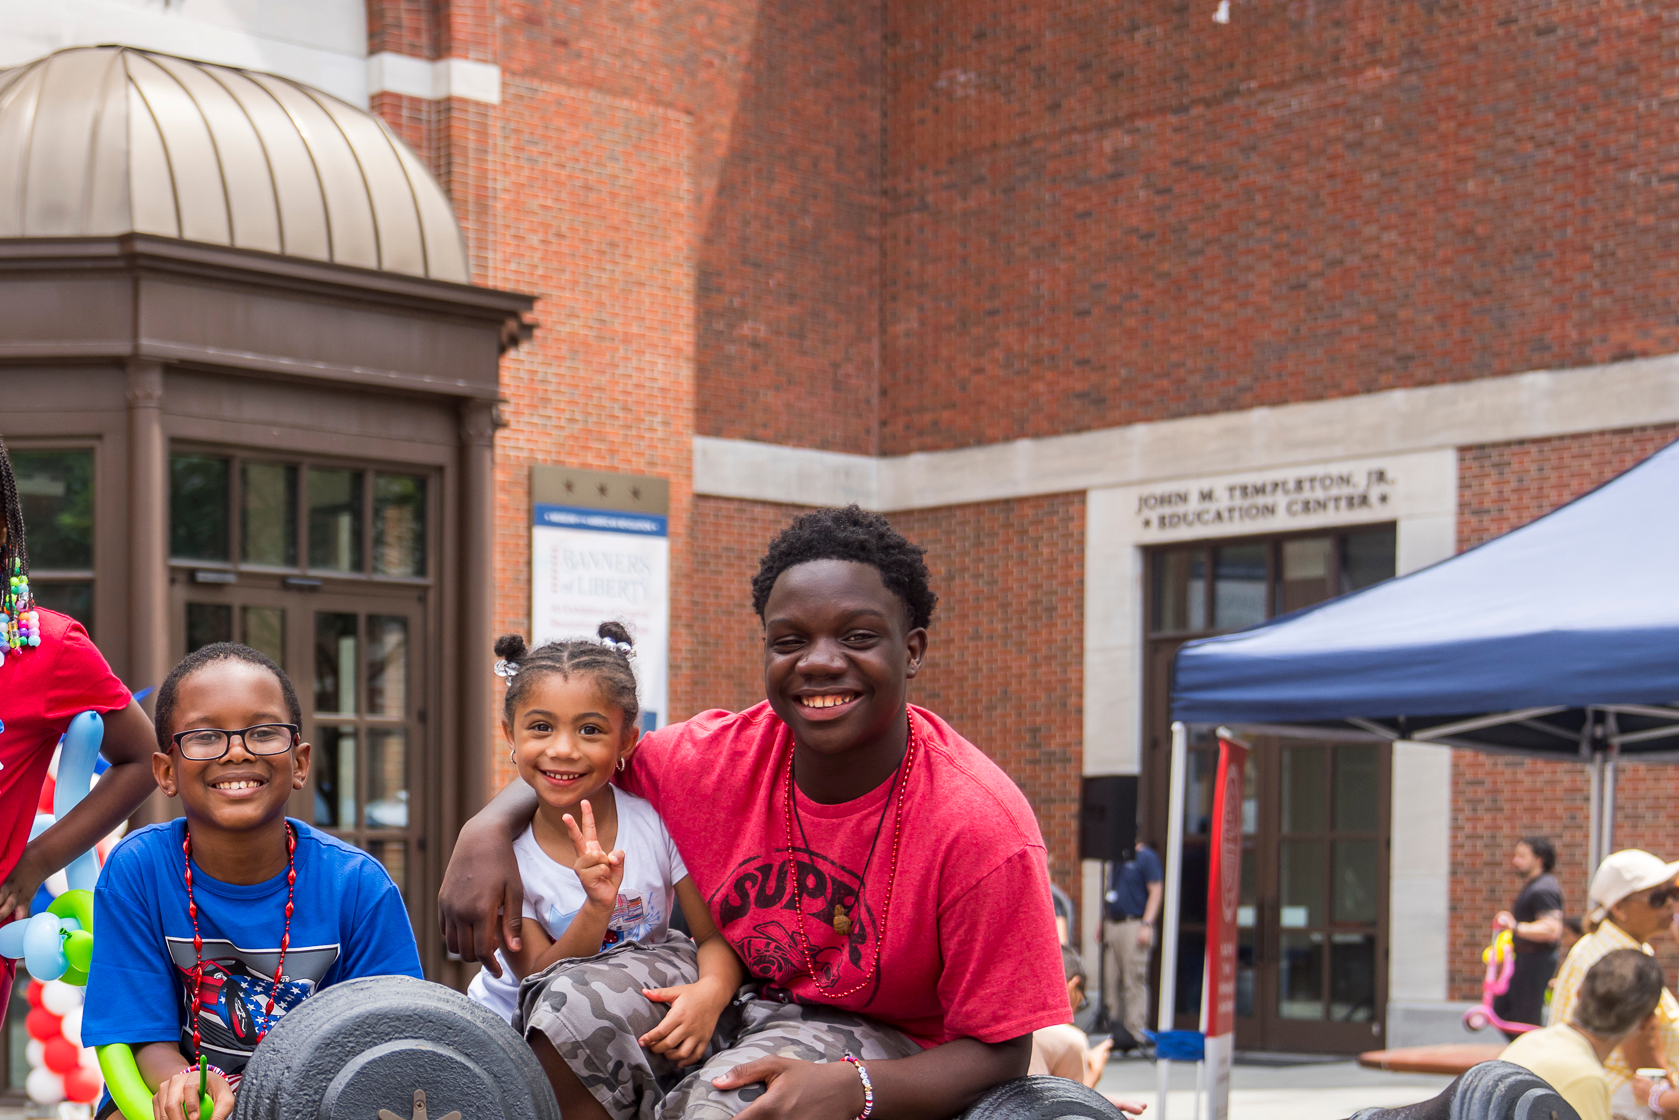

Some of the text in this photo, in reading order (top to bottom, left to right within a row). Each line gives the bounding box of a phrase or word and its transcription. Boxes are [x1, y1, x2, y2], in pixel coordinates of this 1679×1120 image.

[1137, 488, 1189, 514] JOHN
[1198, 486, 1220, 503] M.
[1364, 468, 1396, 490] JR.
[1157, 493, 1371, 530] EDUCATION CENTER
[561, 549, 649, 580] BANNERS
[578, 575, 649, 605] LIBERTY
[720, 859, 867, 972] SUPER
